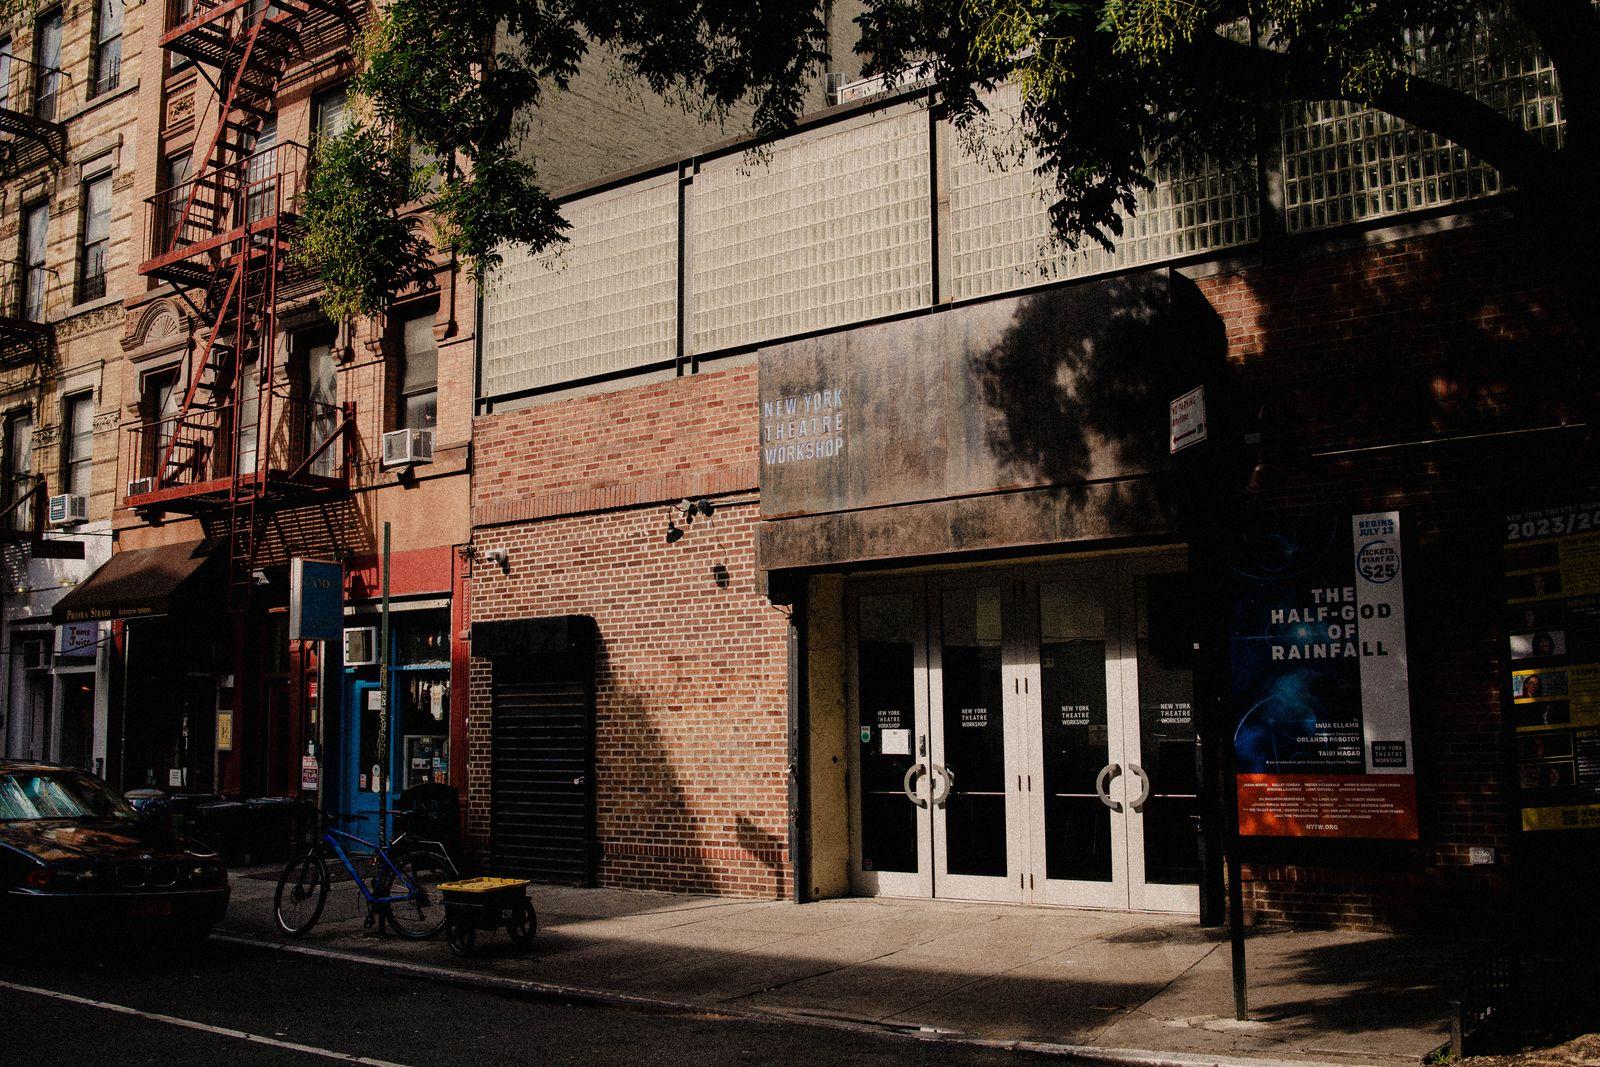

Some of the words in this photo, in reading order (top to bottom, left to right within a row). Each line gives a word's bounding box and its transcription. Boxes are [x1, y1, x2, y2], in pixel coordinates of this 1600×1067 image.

[764, 396, 797, 418] NEW
[803, 389, 842, 416] YORK
[764, 411, 843, 442] THEATRE
[765, 437, 843, 465] WORKSHOP
[1358, 519, 1394, 529] BEGINS
[1358, 527, 1380, 536] JULY
[1382, 526, 1394, 535] 13
[1361, 556, 1384, 564] START
[1362, 548, 1394, 556] TICKETS
[1363, 564, 1395, 578] $25
[1311, 586, 1355, 603] THE
[1270, 604, 1391, 624] HALF-GOD
[1327, 624, 1357, 640] OF
[1271, 641, 1388, 660] RAINFALL
